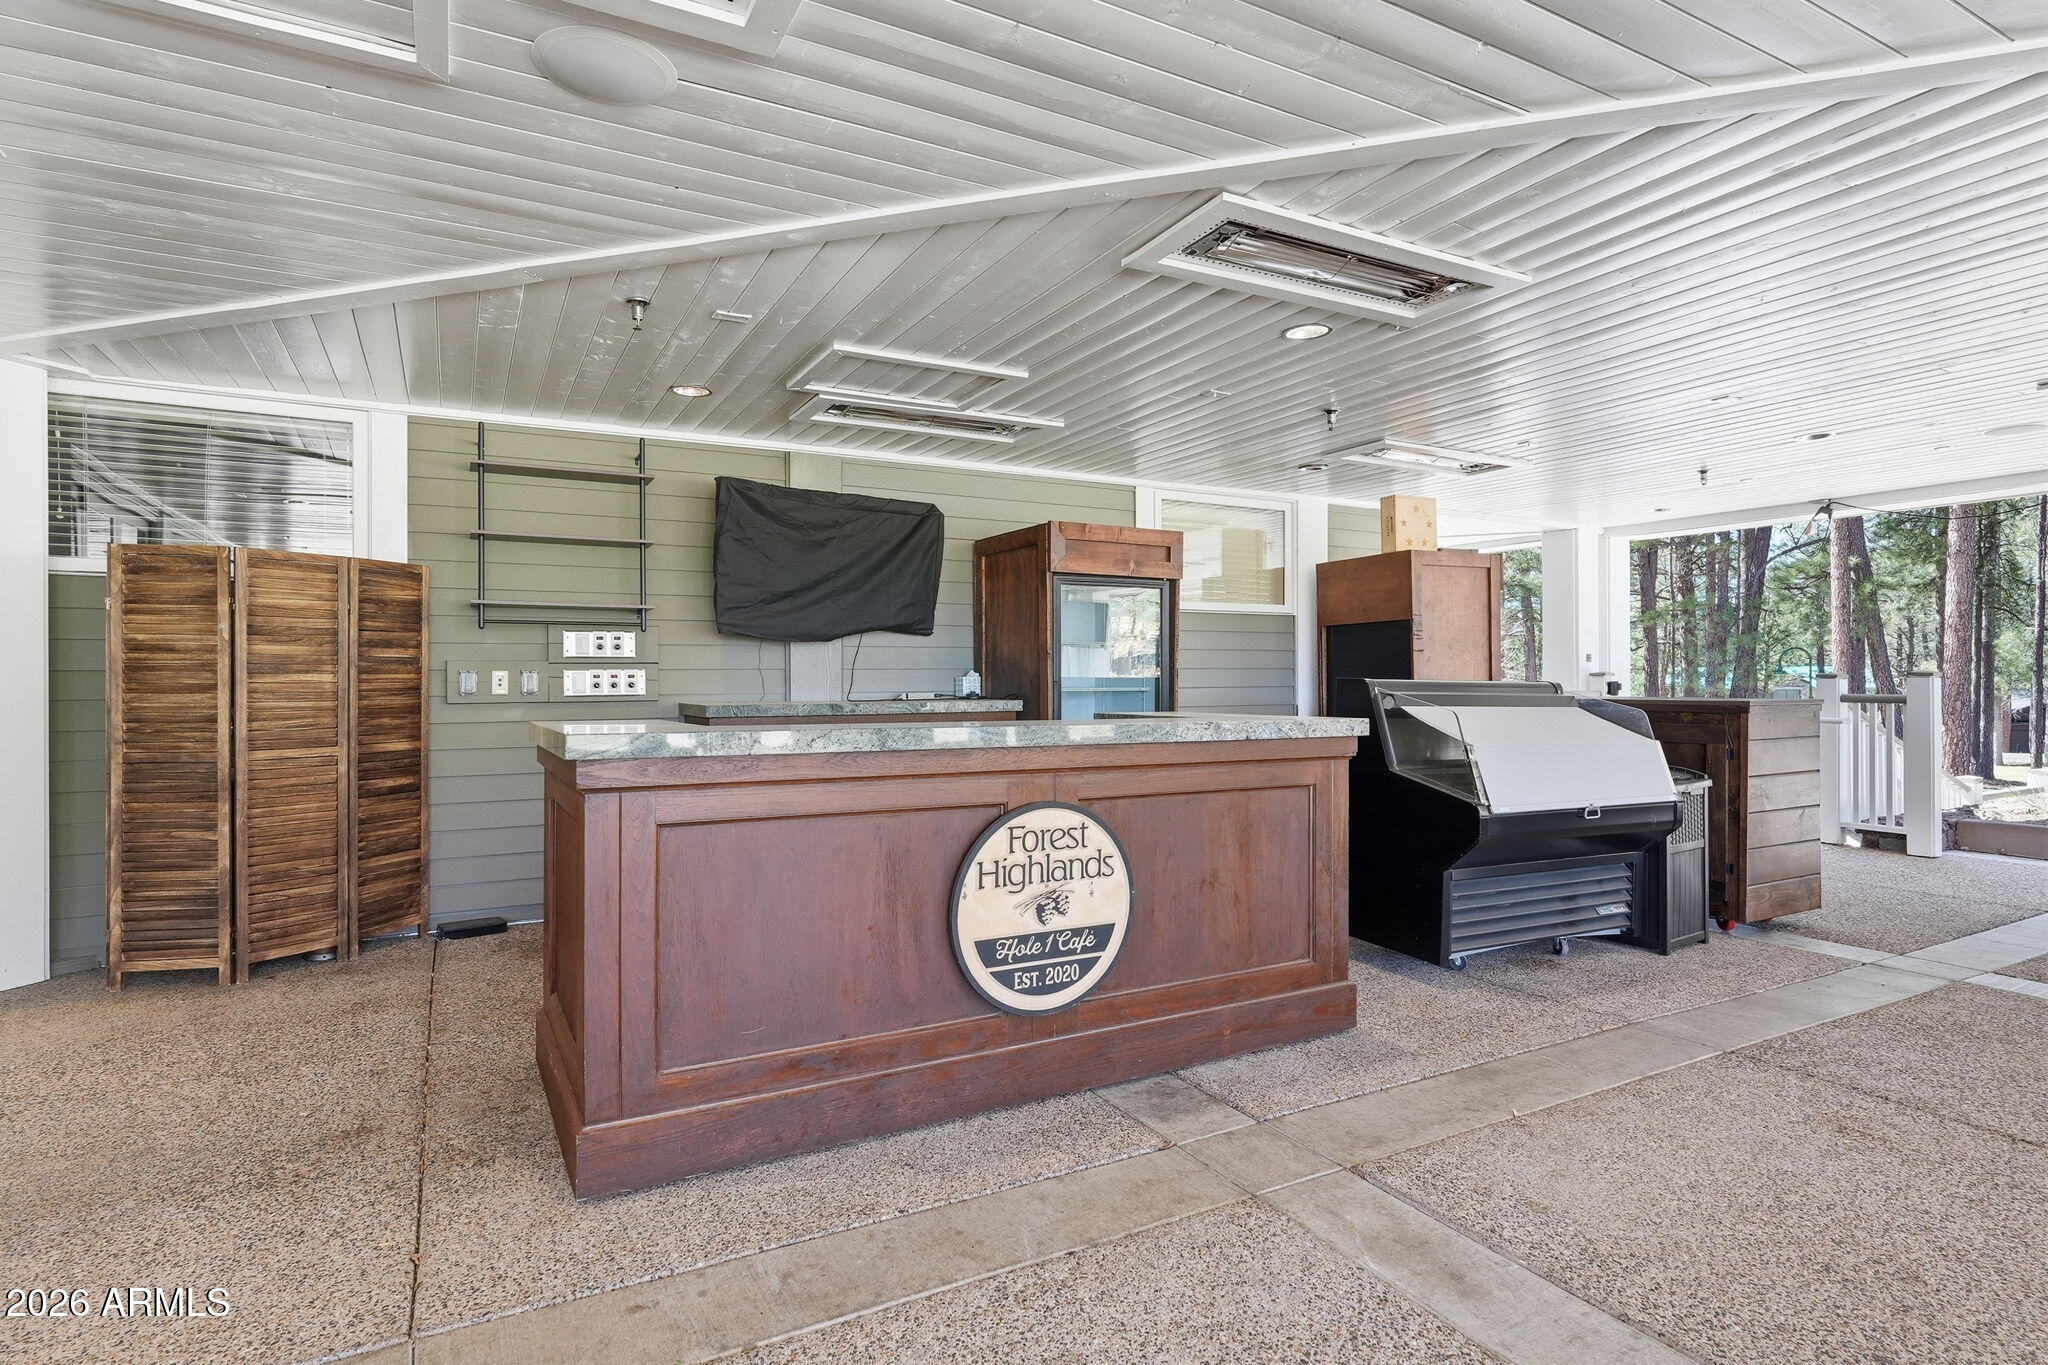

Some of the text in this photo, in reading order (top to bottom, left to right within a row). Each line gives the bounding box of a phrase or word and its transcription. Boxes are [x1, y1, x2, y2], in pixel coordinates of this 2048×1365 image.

[1007, 821, 1089, 854] Forest
[977, 849, 1115, 894] Highlands
[996, 929, 1096, 963] Hole 1 Café
[1013, 963, 1080, 990] EST. 2020
